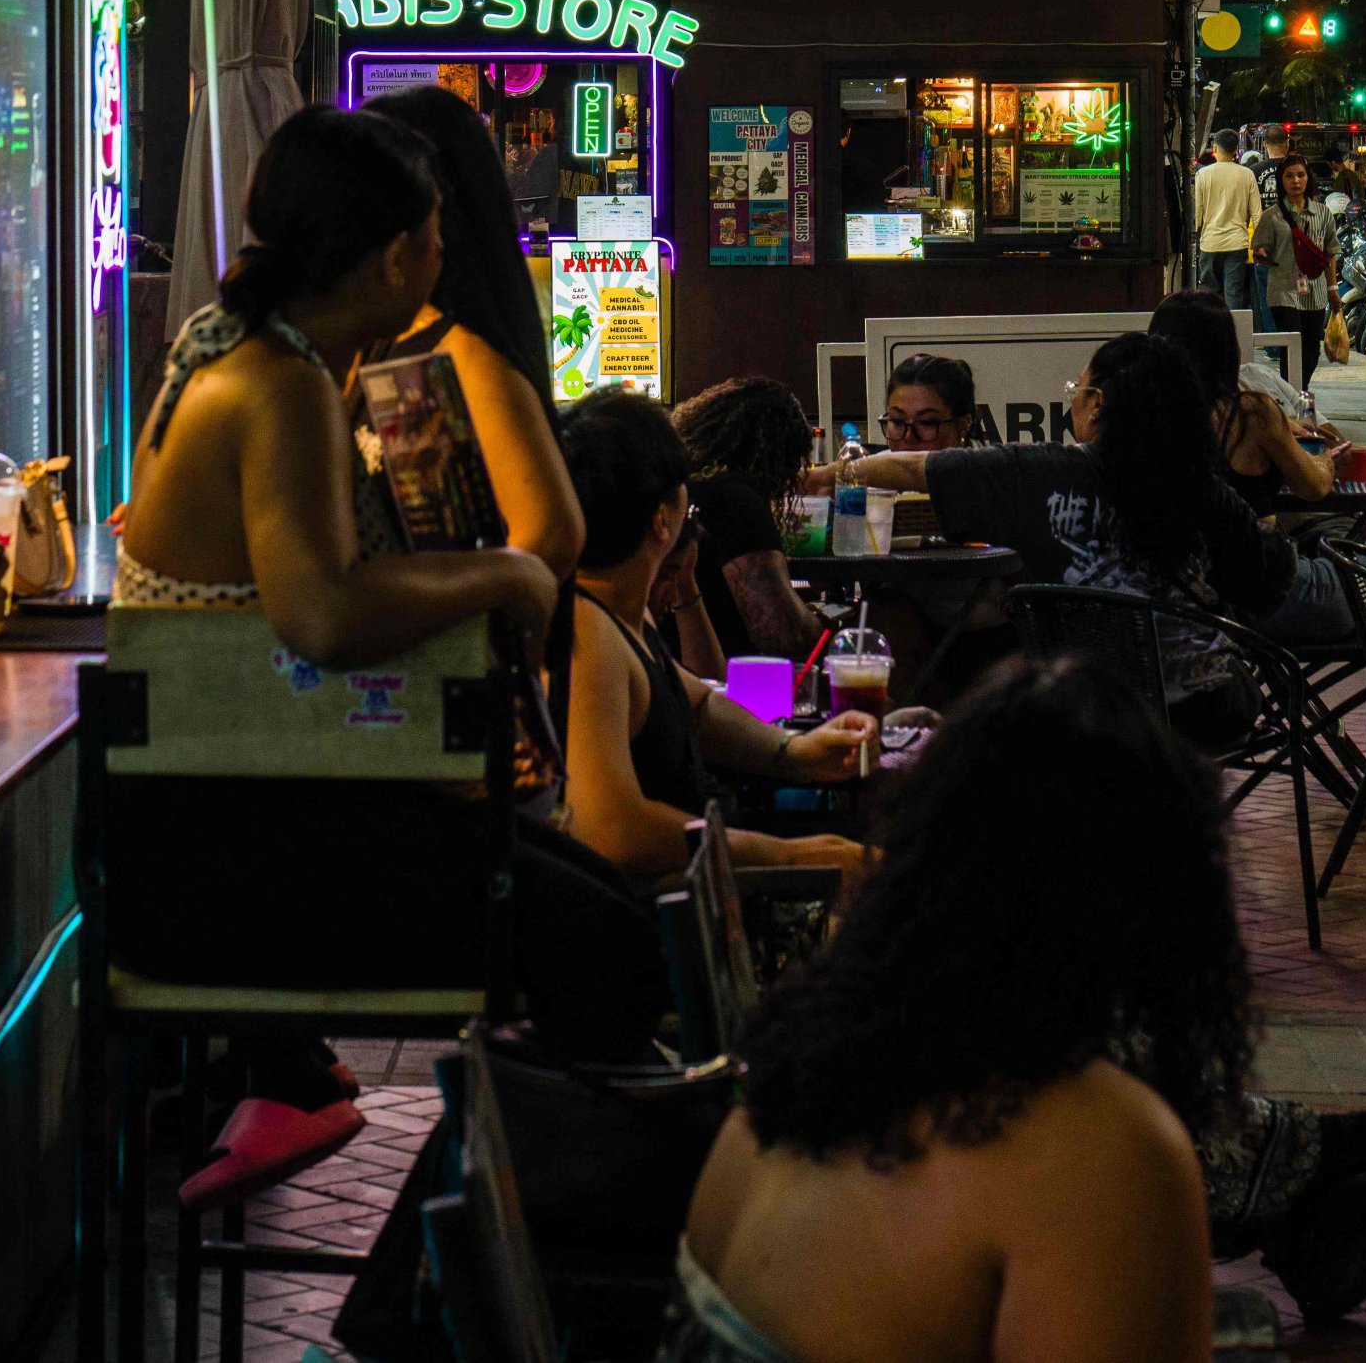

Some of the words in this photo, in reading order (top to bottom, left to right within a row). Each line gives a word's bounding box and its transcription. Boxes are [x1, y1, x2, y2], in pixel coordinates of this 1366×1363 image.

[584, 85, 602, 154] OPEN
[711, 109, 758, 123] WELCOME
[736, 125, 777, 138] PATTAYA
[747, 138, 767, 151] CITY
[794, 142, 808, 187] MEDICAL
[795, 191, 809, 243] CANNABIS
[570, 250, 642, 260] KRYPTONITE
[563, 257, 648, 273] PATTAYA
[609, 296, 641, 304] MEDICAL
[605, 304, 645, 312] CANNABIS
[609, 326, 644, 334] MEDICINE
